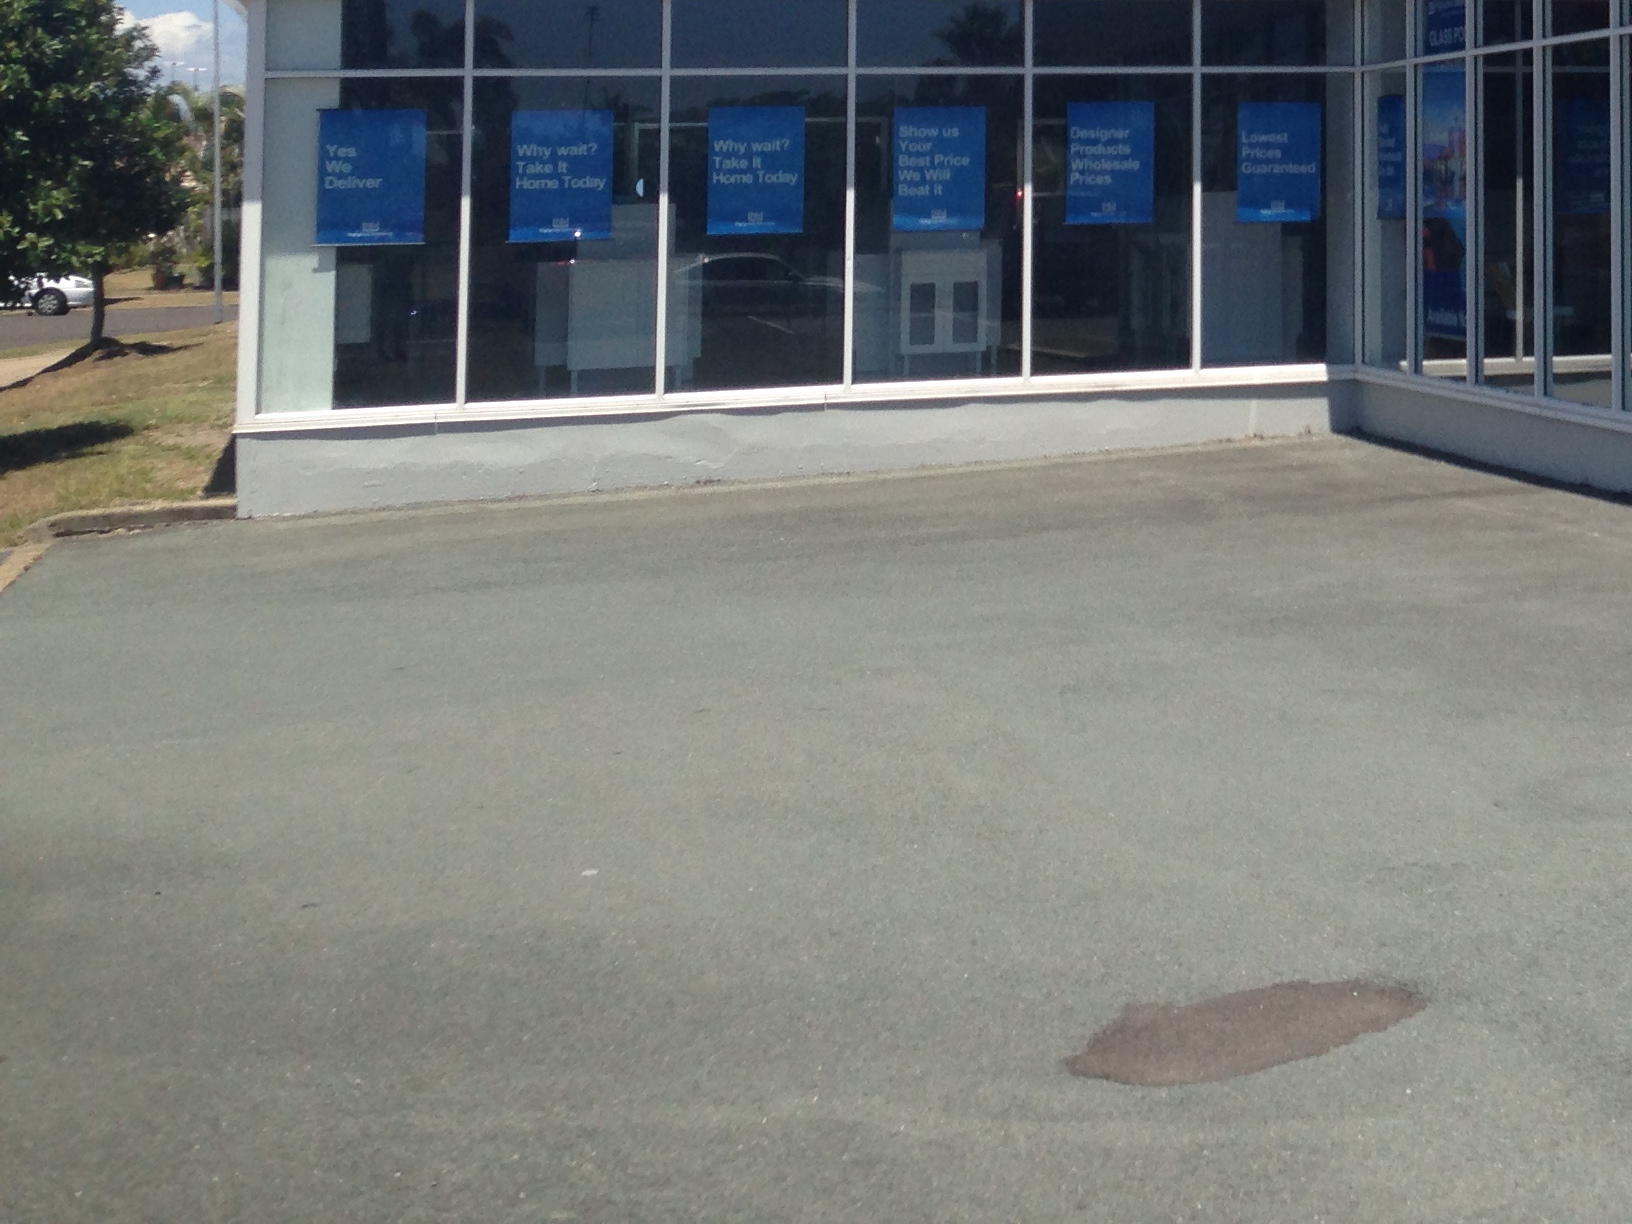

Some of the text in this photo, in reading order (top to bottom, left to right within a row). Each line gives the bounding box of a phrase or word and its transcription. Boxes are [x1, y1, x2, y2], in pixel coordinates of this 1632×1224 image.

[899, 125, 959, 138] Show us
[1070, 125, 1129, 142] Designer
[1241, 130, 1288, 144] Lowest
[326, 144, 358, 158] Yes
[517, 142, 598, 160] Why wait?
[713, 138, 790, 155] Why wait?
[899, 140, 932, 153] Your
[1070, 142, 1131, 155] Products
[1241, 145, 1281, 159] Prices
[326, 160, 353, 173] We
[713, 156, 748, 169] Take
[899, 152, 970, 167] Best Price
[1070, 157, 1140, 171] Wholesale
[516, 160, 553, 174] Take
[1241, 161, 1316, 174] Guaranteed
[324, 175, 383, 190] Deliver
[712, 170, 798, 186] Home Today
[898, 169, 920, 182] We
[1070, 171, 1112, 185] Prices
[515, 175, 608, 191] Home Today
[898, 183, 930, 196] Beat
